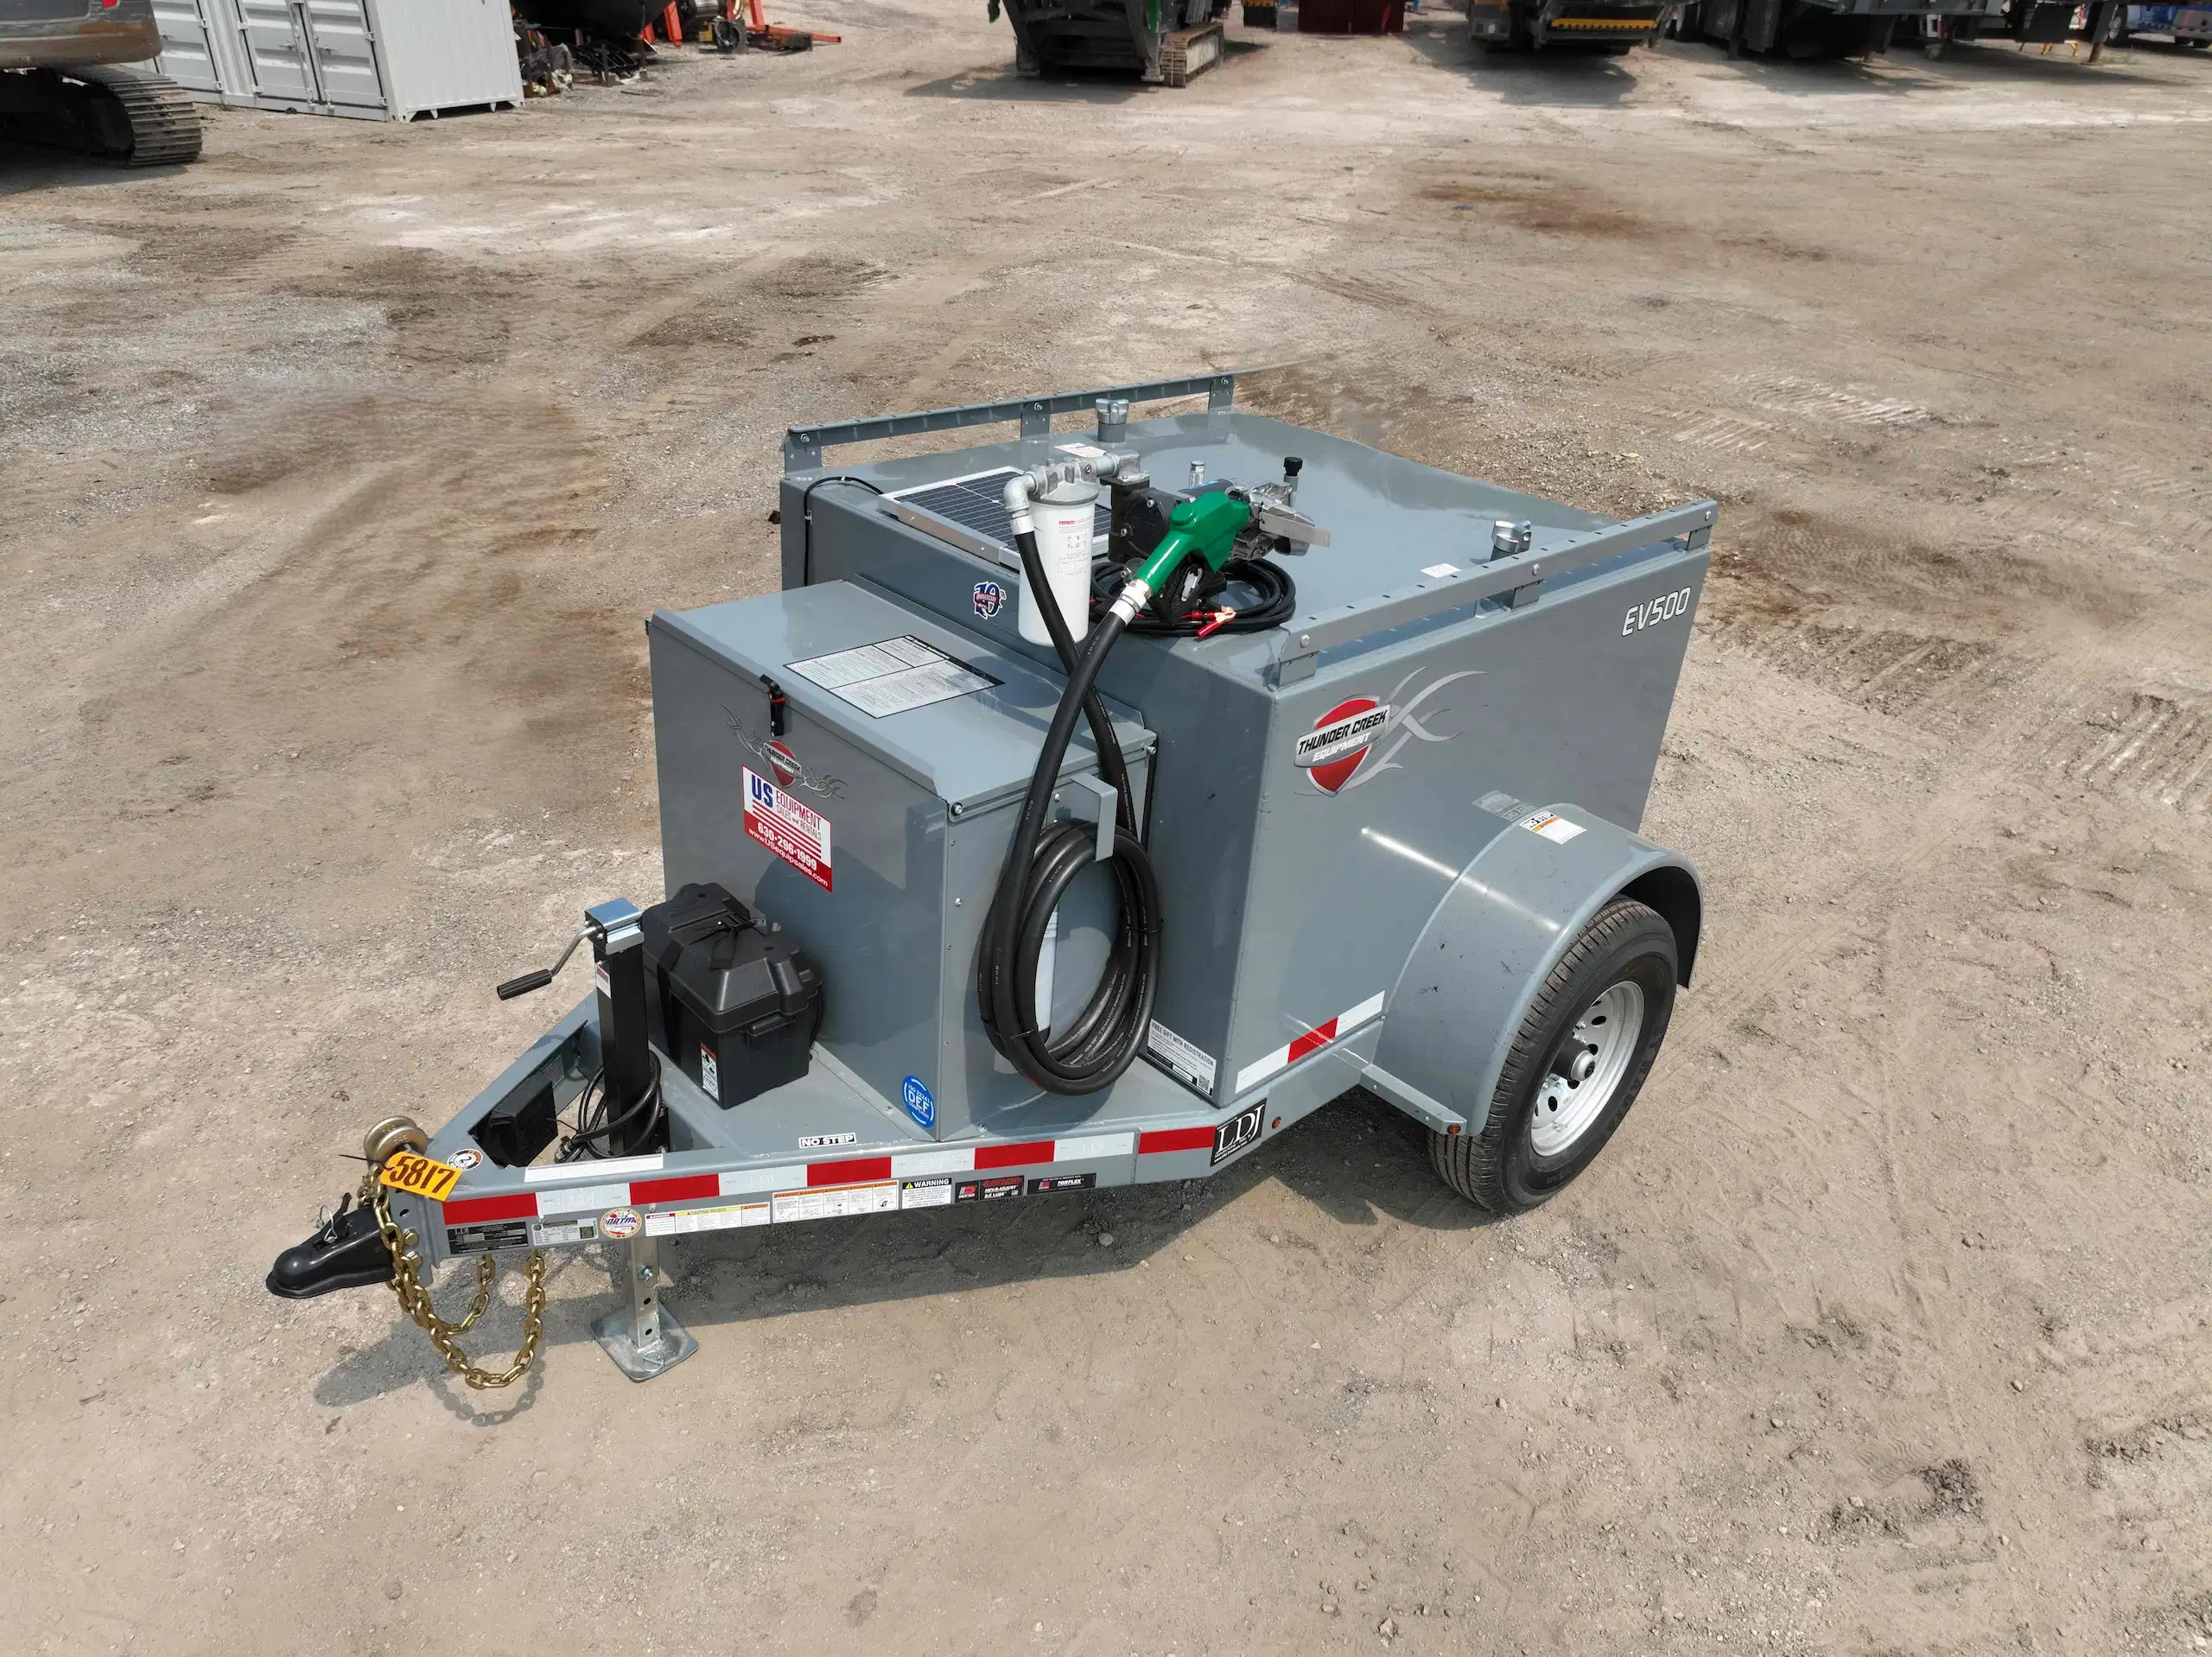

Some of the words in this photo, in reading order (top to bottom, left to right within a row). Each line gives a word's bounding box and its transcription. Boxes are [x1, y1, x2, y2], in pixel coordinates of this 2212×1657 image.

[1622, 586, 1691, 637] EV500
[1299, 723, 1351, 755] THUNDER
[1351, 709, 1388, 735] CREEK
[1313, 731, 1371, 762] EQUIPMENT
[765, 744, 785, 762] THUNDER
[785, 757, 801, 772] CREEK
[776, 790, 822, 831] EQUIPMENT
[776, 804, 791, 822] SALES
[1152, 1021, 1163, 1033] FREE
[1163, 1028, 1173, 1039] GIFT
[1173, 1035, 1184, 1047] WITH
[1184, 1043, 1214, 1067] REGISTRATION
[908, 1089, 931, 1113] DEF
[801, 1138, 821, 1147] NO
[822, 1134, 855, 1145] STEP
[1215, 1103, 1266, 1155] LDJ
[389, 1155, 456, 1194] 5817
[913, 1178, 950, 1188] WARNING
[1057, 1178, 1082, 1187] TORFLEX
